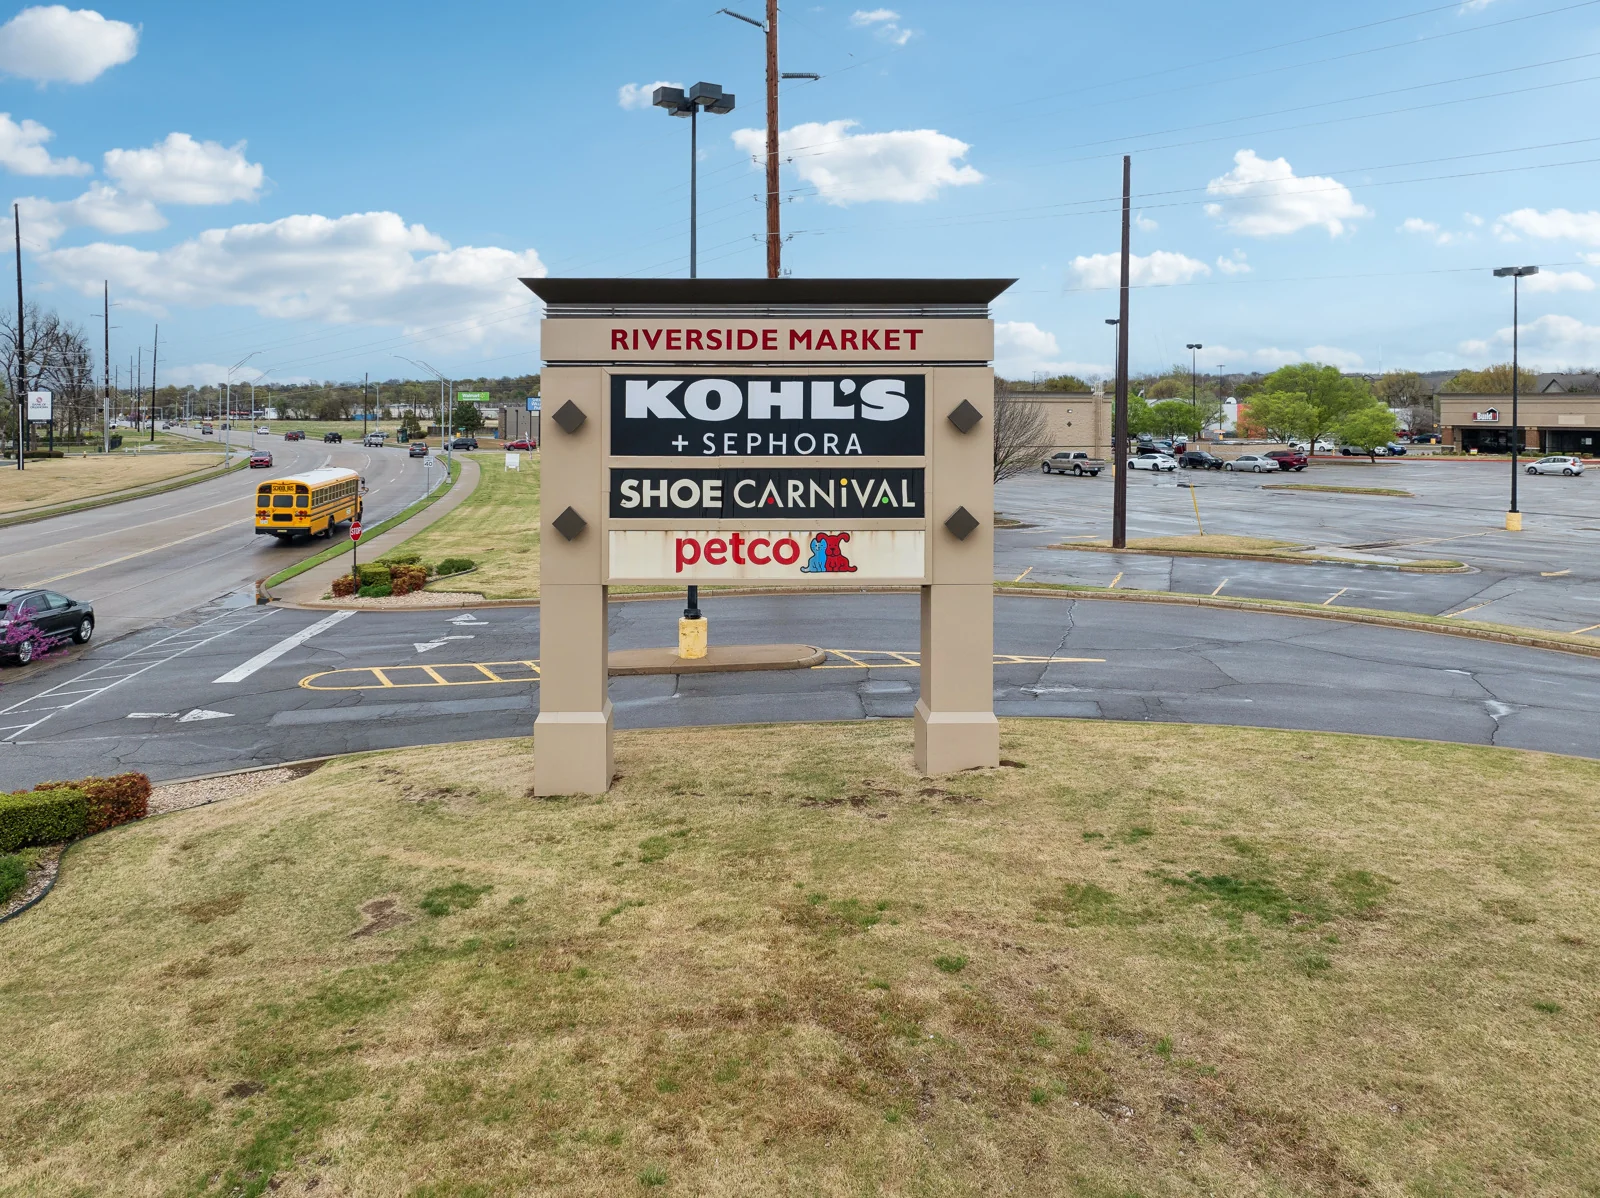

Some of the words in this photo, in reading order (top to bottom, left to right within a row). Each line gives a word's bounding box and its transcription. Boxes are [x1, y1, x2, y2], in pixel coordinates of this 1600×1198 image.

[611, 329, 778, 350] RIVERSIDE
[789, 329, 923, 350] MARKET
[625, 378, 910, 422] KOHL'S
[702, 432, 863, 455] SEPHORA
[619, 478, 723, 509] SHOE
[350, 526, 362, 535] STOP
[675, 532, 800, 573] petco
